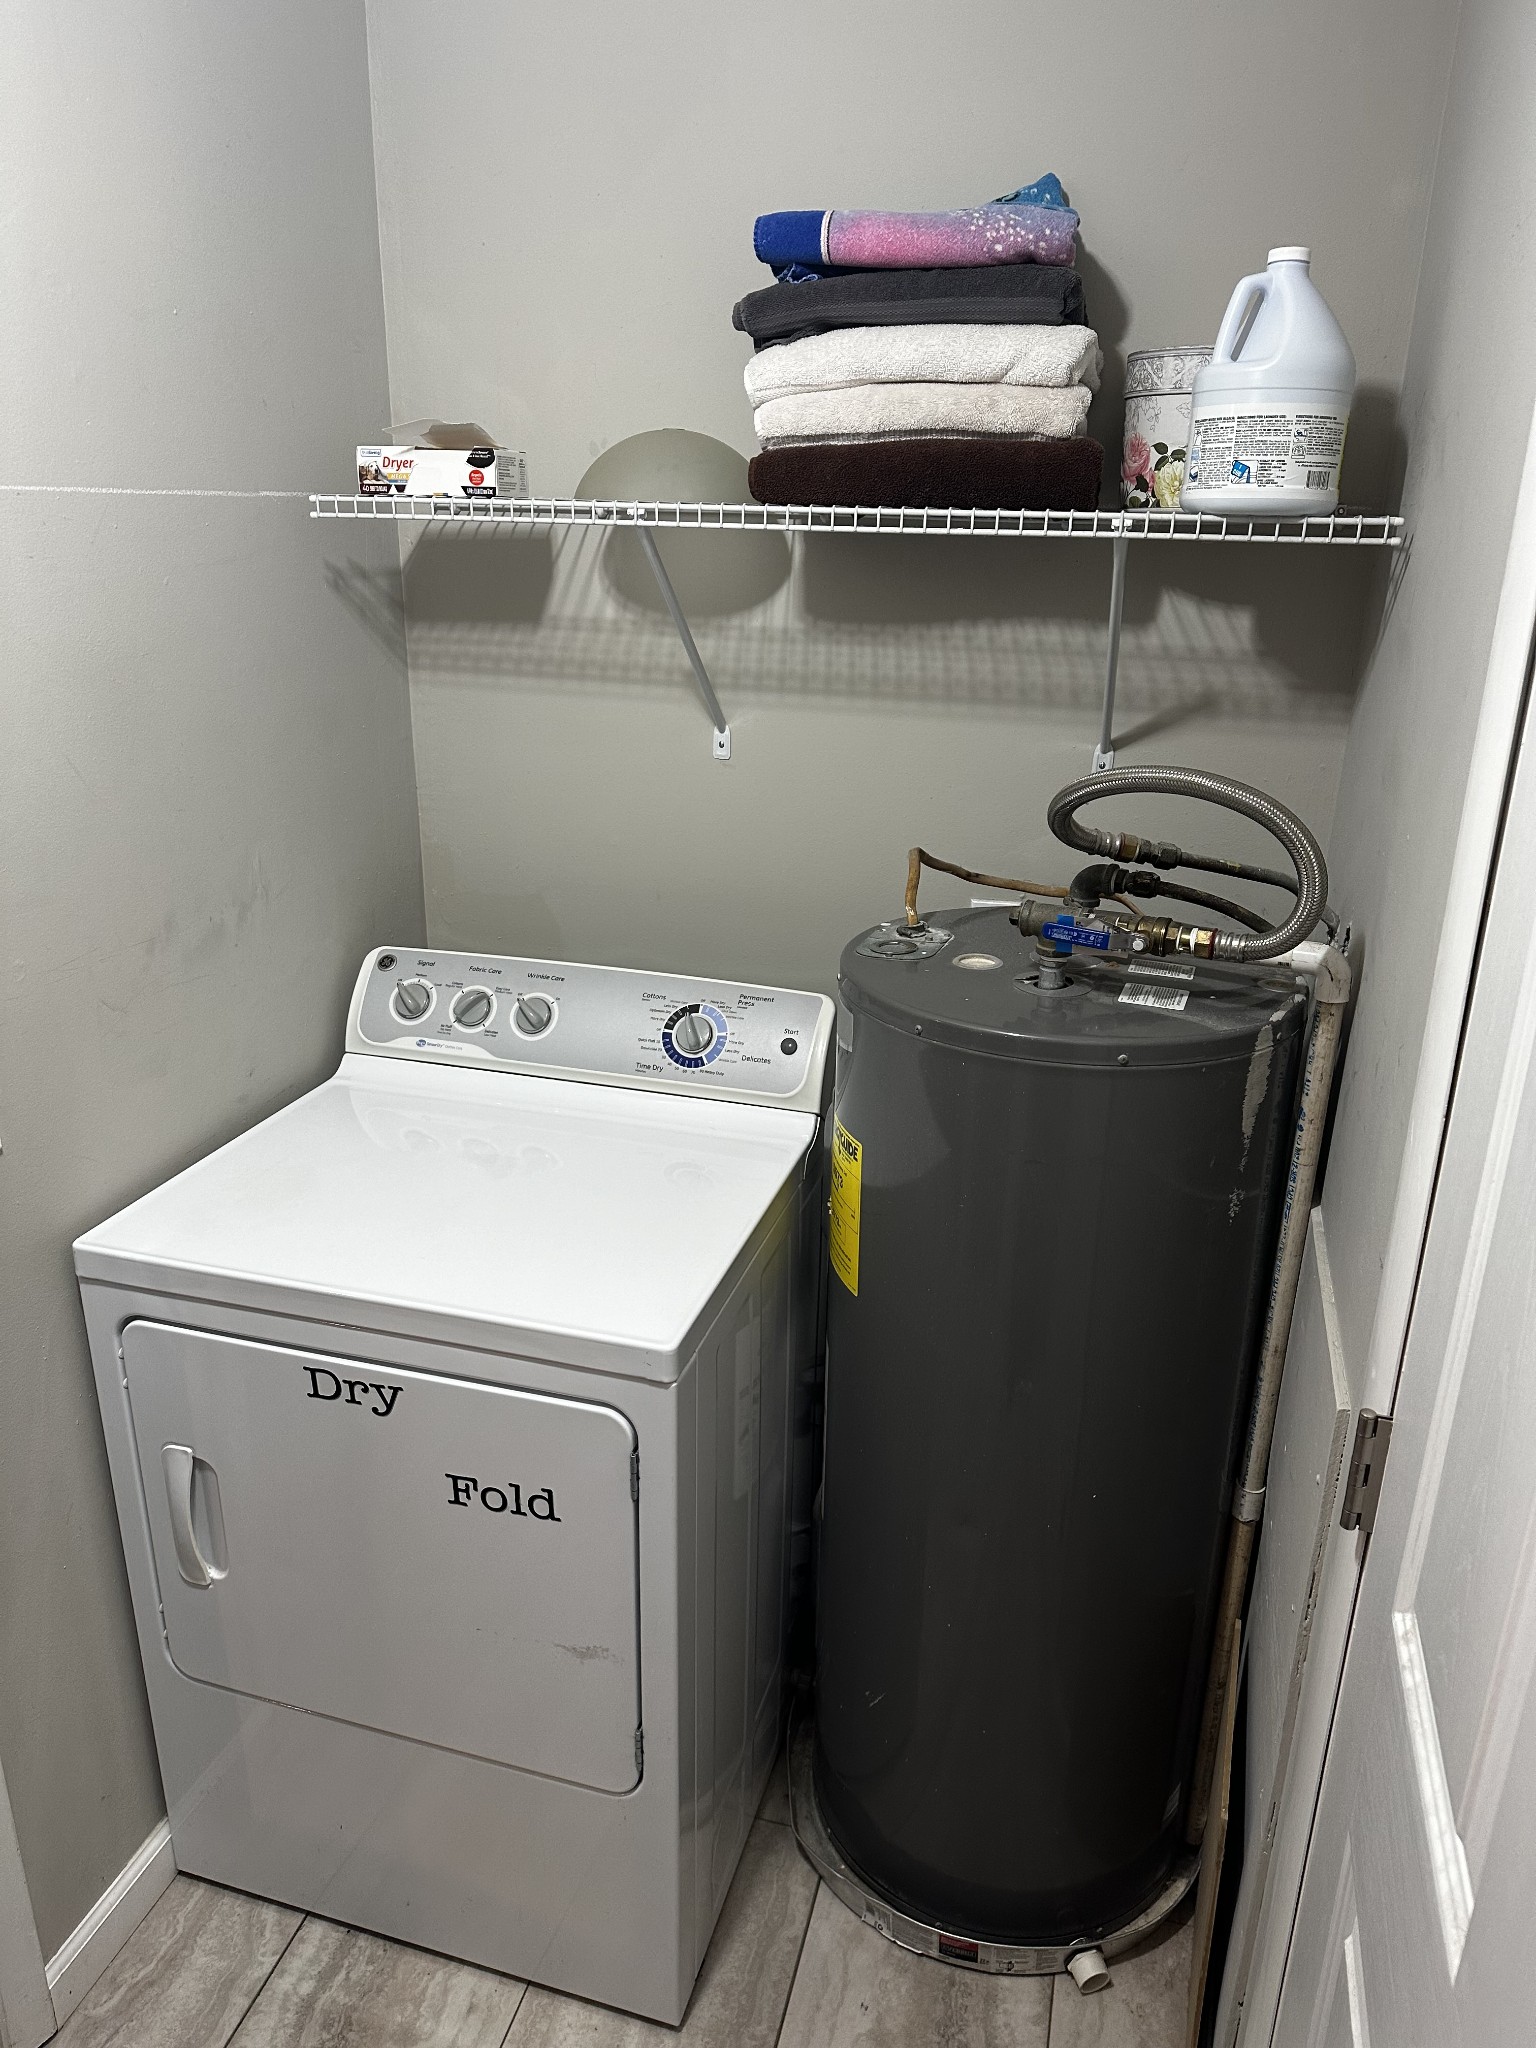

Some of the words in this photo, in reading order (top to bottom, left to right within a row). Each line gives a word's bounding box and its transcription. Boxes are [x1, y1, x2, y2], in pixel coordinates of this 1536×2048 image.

[382, 456, 414, 471] Dryer
[417, 959, 436, 967] Signal
[469, 965, 487, 973] Fabric
[527, 972, 549, 981] Wrinkle
[550, 974, 565, 982] Care
[643, 992, 667, 1000] Cottons
[739, 993, 775, 1003] Permanent
[784, 1028, 799, 1036] Start
[741, 1054, 772, 1065] Delicates
[636, 1061, 652, 1069] Time
[652, 1064, 664, 1073] Dry
[302, 1366, 404, 1417] Dry
[444, 1472, 562, 1523] Fold
